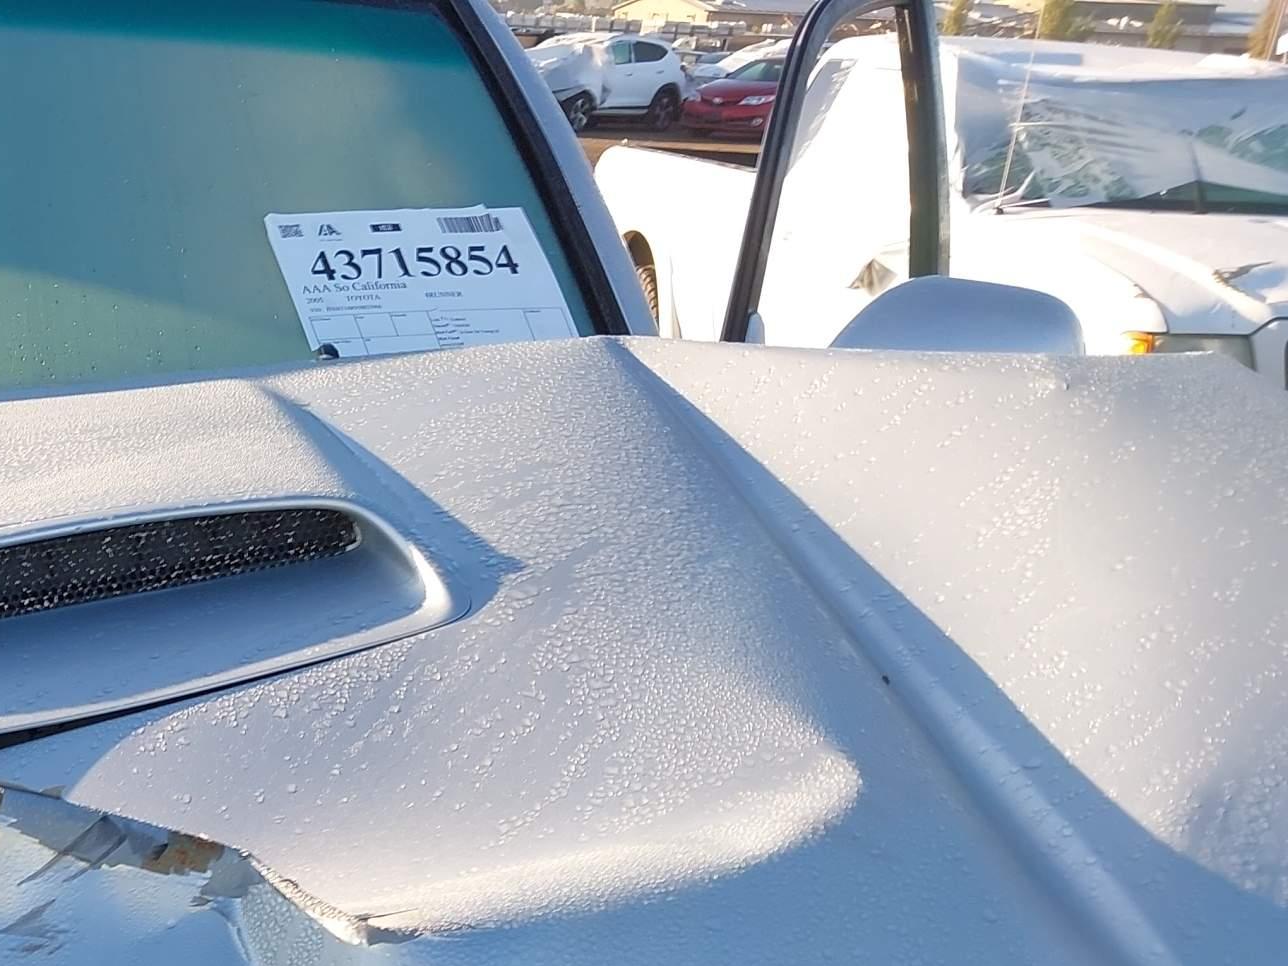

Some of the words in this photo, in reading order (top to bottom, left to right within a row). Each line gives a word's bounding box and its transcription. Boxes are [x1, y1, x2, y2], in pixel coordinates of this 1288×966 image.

[311, 244, 519, 281] 43715854
[302, 284, 331, 295] AAA
[333, 282, 350, 292] So
[351, 280, 407, 291] California
[346, 293, 381, 302] TOYOTA
